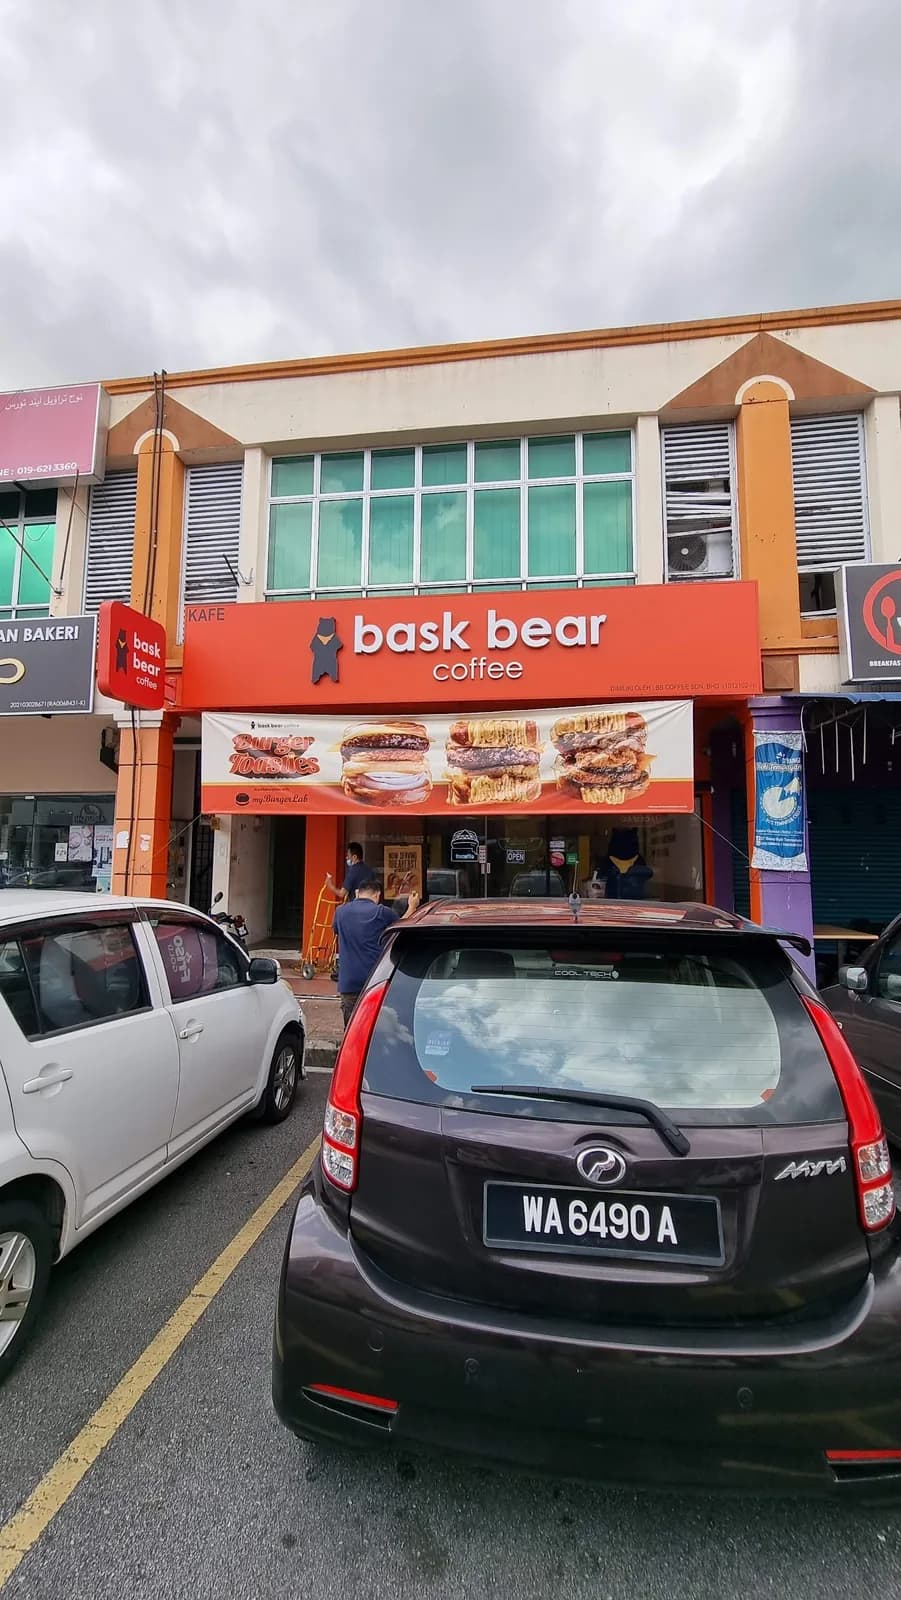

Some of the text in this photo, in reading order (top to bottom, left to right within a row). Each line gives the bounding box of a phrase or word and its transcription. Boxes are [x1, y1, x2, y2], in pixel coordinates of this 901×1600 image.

[16, 461, 78, 476] 019-6213360
[188, 608, 225, 622] KAFE
[23, 625, 79, 642] BAKERI
[354, 609, 608, 654] bask bear
[133, 631, 161, 659] bask
[132, 651, 161, 677] bear
[432, 656, 524, 681] coffee
[136, 676, 158, 690] coffee
[232, 733, 315, 756] Burger
[228, 752, 320, 776] Toasties
[507, 852, 525, 861] OPEN
[583, 970, 611, 978] TECH
[523, 1195, 678, 1245] WA 6490 A
